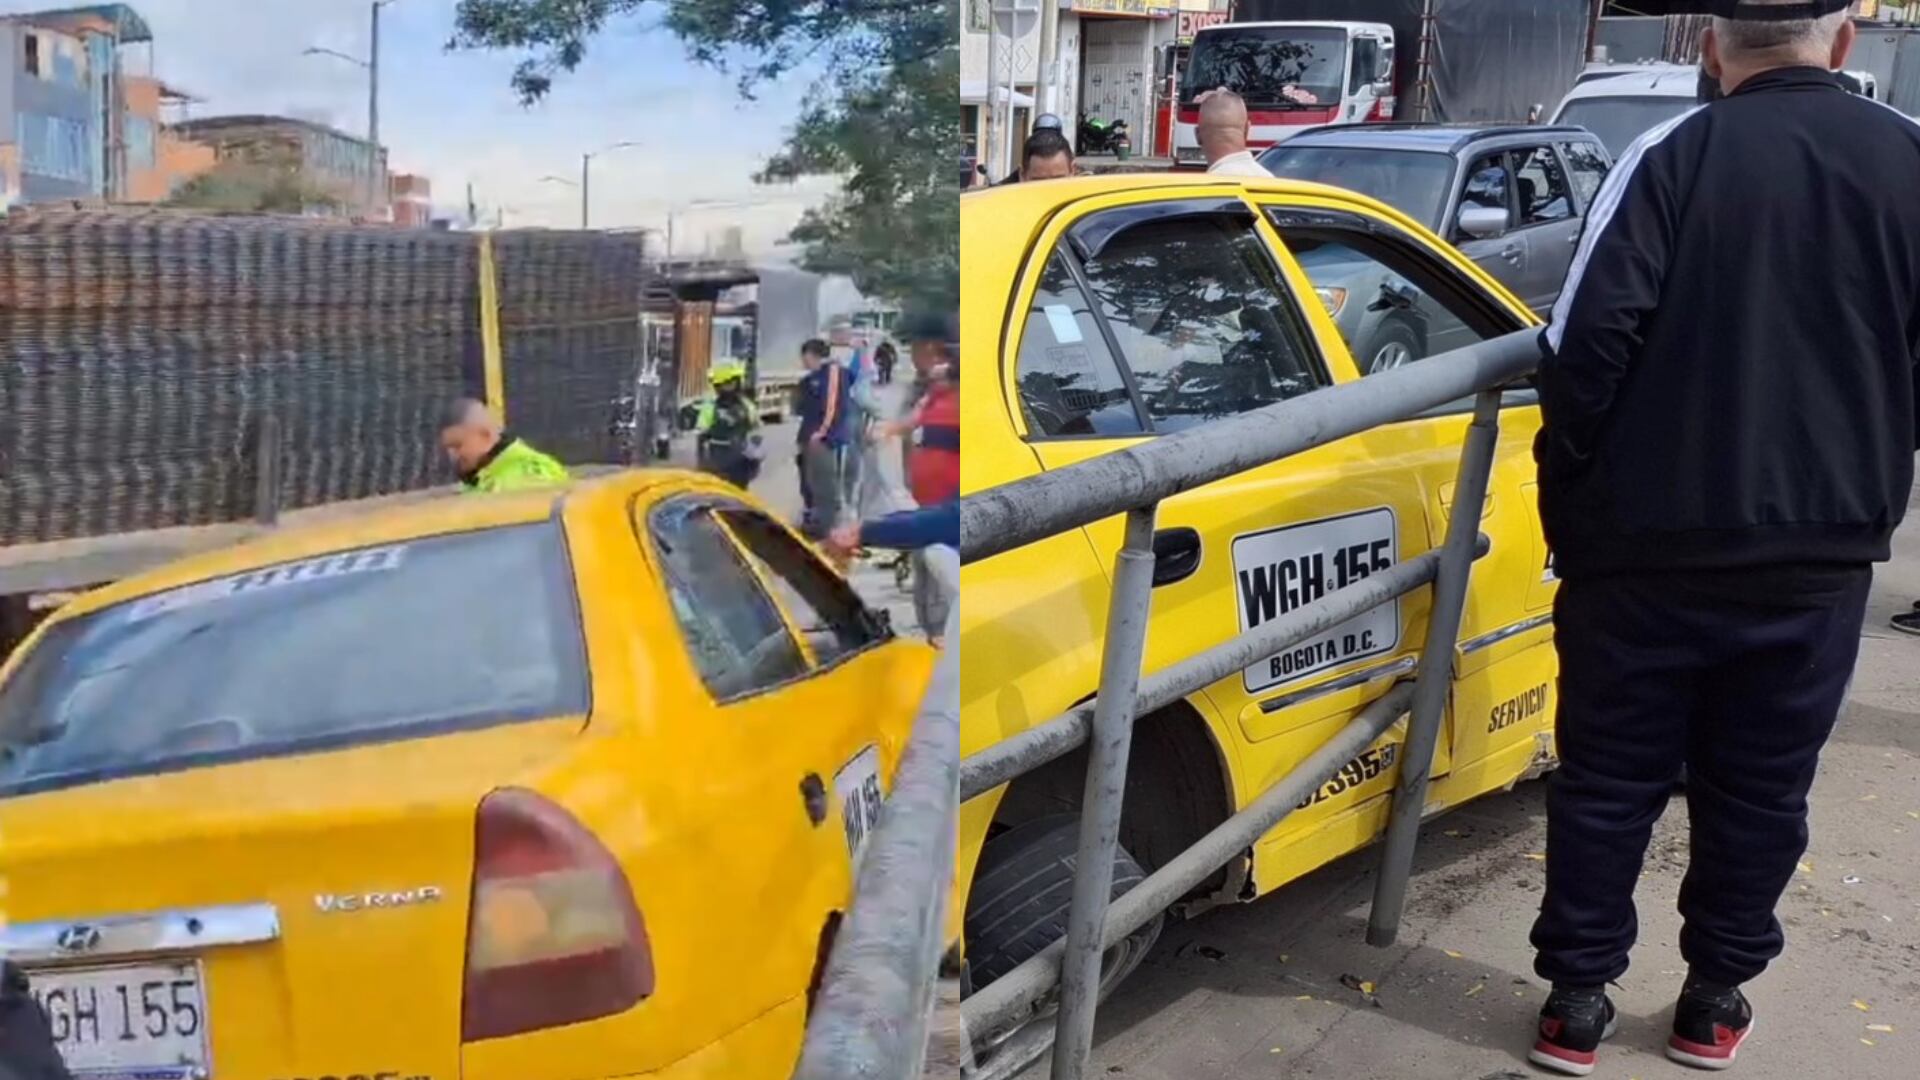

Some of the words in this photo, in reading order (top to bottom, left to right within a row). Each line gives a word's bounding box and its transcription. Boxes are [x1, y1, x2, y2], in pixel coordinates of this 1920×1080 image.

[1239, 553, 1324, 628] WGH
[1333, 539, 1391, 589] 155
[1270, 639, 1337, 679] BOGOTA
[1343, 630, 1377, 656] D.C.
[116, 979, 199, 1041] 155
